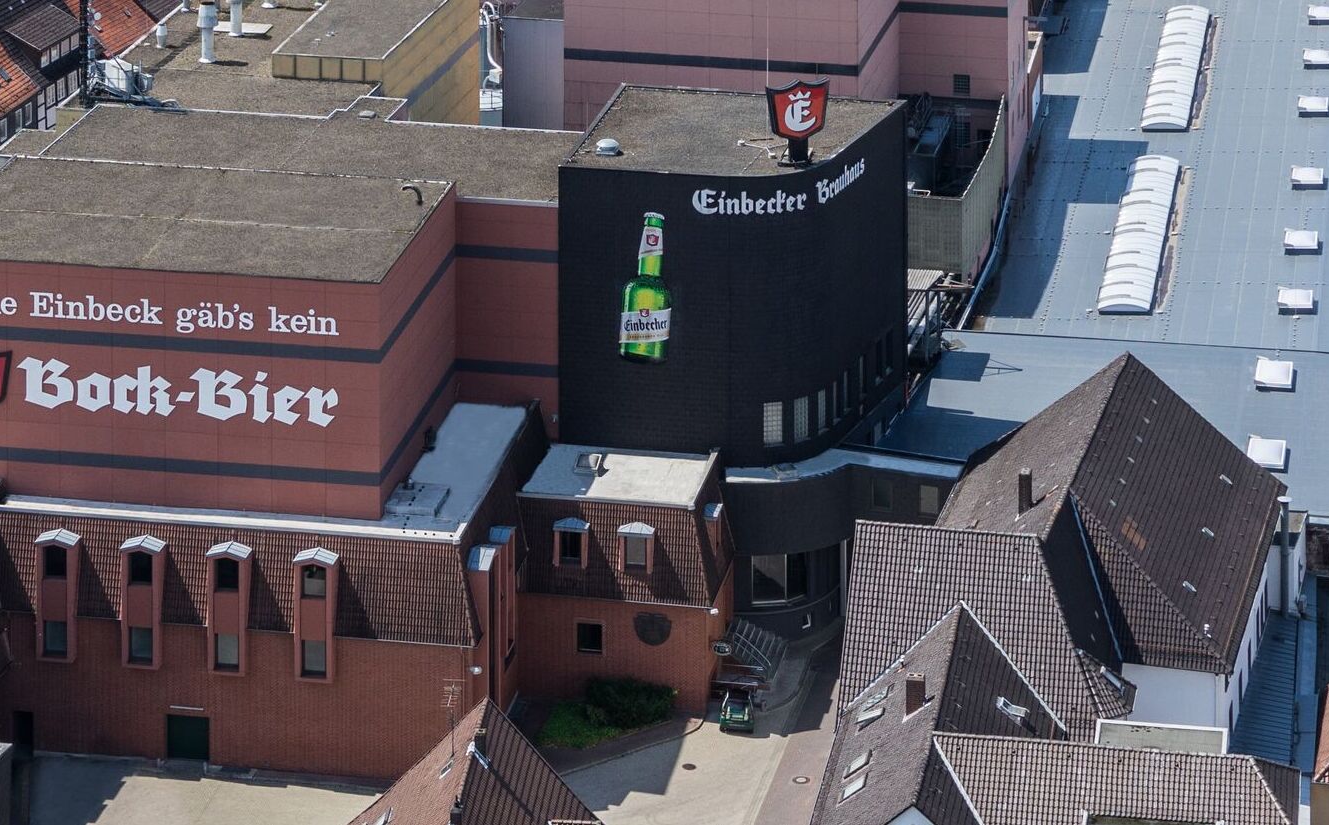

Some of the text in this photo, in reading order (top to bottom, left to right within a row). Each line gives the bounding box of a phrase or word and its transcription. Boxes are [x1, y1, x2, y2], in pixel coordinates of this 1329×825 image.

[692, 157, 865, 216] Einbecker Brauhaus
[29, 291, 163, 325] Einbeck
[176, 302, 254, 334] gäb's
[267, 306, 340, 336] kein
[624, 317, 668, 332] Einbecker
[16, 356, 339, 428] Bock-Bier
